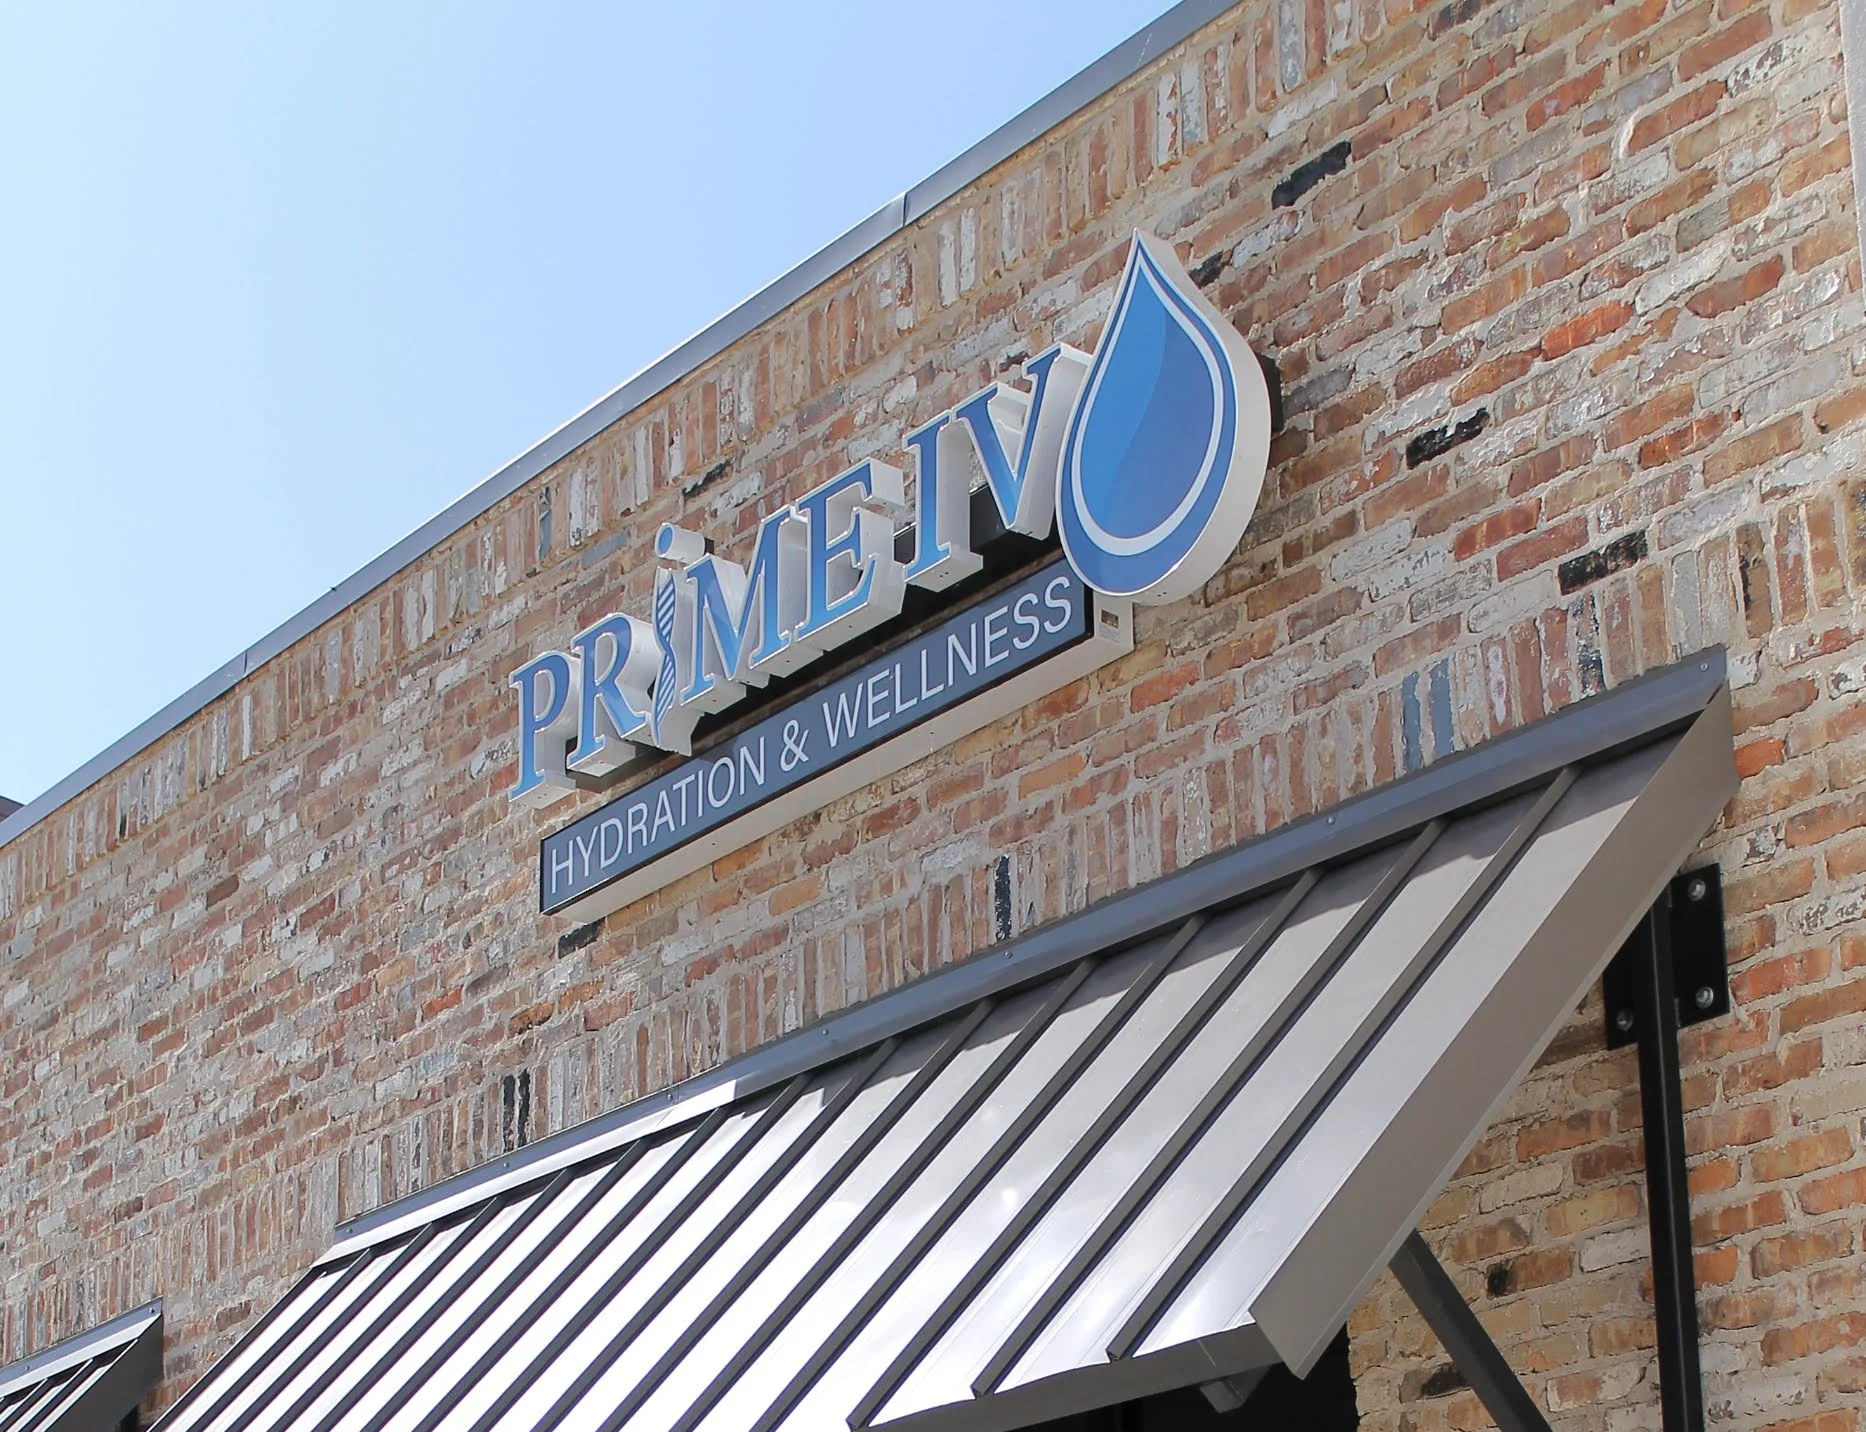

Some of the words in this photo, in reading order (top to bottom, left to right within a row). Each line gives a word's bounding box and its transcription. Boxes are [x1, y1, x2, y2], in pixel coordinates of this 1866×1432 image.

[903, 342, 1062, 579] IV
[549, 736, 766, 893] HYDRATION
[779, 719, 811, 771] &
[823, 576, 1072, 747] WELLNESS
